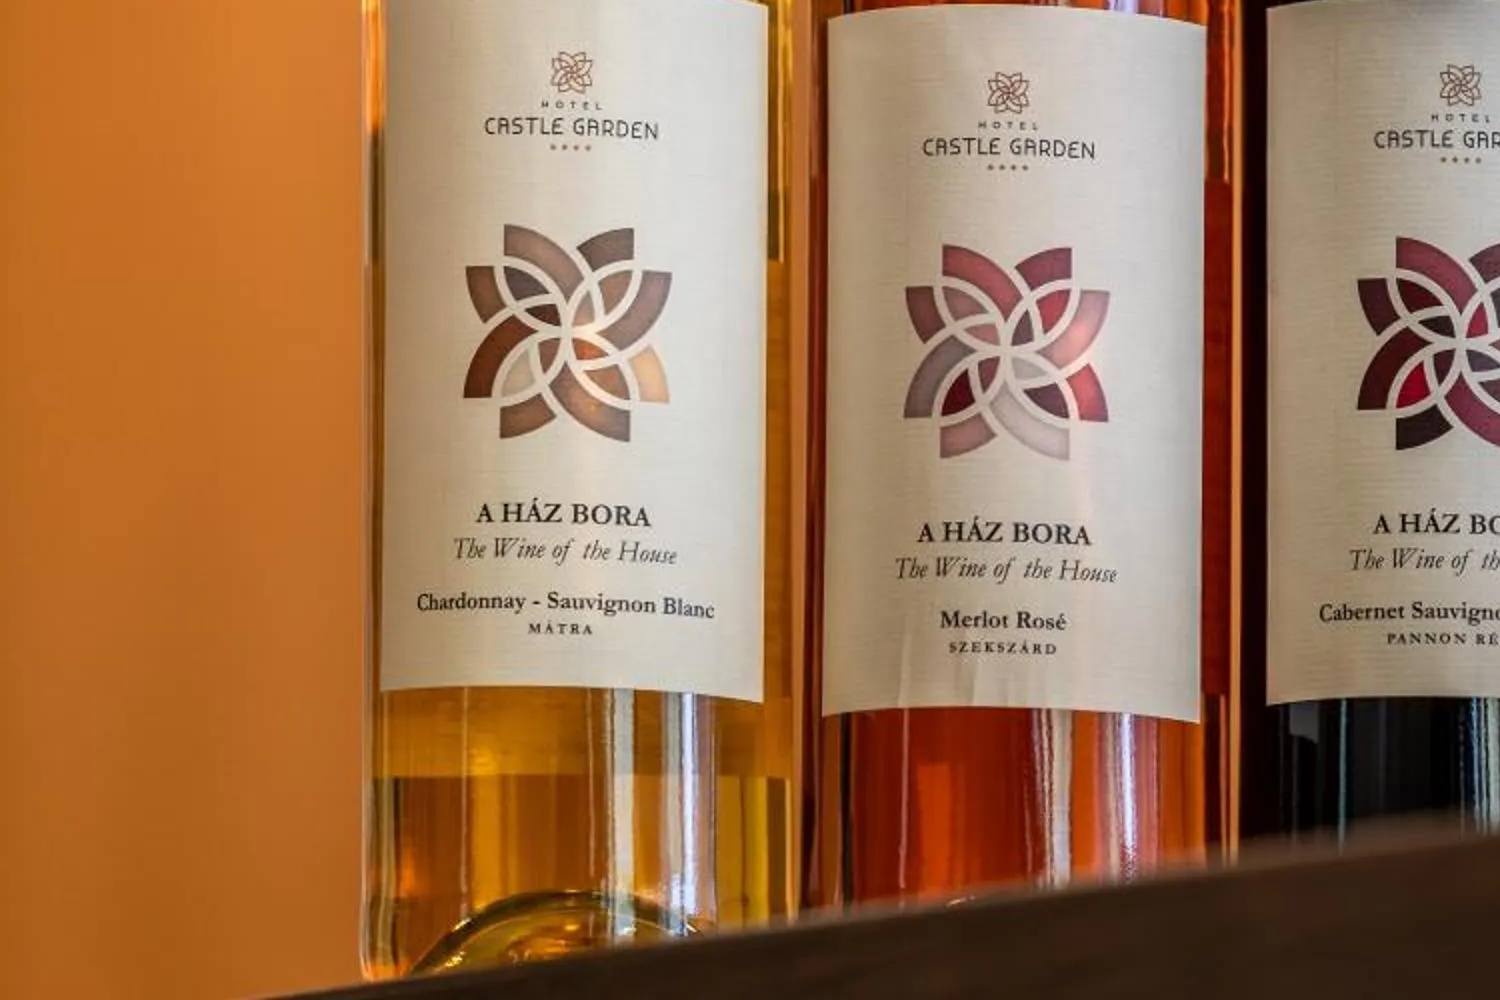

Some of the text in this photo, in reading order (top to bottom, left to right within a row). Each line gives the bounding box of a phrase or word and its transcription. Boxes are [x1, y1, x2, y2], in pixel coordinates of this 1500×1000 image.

[541, 101, 602, 110] HOTEL
[484, 117, 659, 140] CASTLE GARDEN
[978, 121, 1039, 130] HOTEL
[1431, 114, 1491, 123] HOTEL
[923, 137, 1095, 159] CASTLE GARDEN
[1374, 129, 1453, 148] CASTLE
[476, 498, 652, 527] A HÁZ BORA
[1373, 515, 1391, 534] A
[1400, 508, 1461, 534] HÁZ
[917, 516, 1092, 545] A HÁZ BORA
[454, 538, 677, 566] The Wine of the House
[1349, 549, 1384, 571] The
[1392, 548, 1445, 569] Wine
[1451, 549, 1473, 576] of
[895, 557, 1118, 584] The Wine of the House
[417, 592, 526, 615] Chardonnay
[547, 592, 656, 615] Sauvignon
[663, 598, 715, 619] Blanc
[1320, 602, 1404, 623] Cabernet
[529, 622, 592, 635] MÁTRA
[940, 610, 1068, 630] Merlot Rosé
[949, 640, 1057, 655] SZEKSZÁRD
[1387, 633, 1467, 645] PANNON
